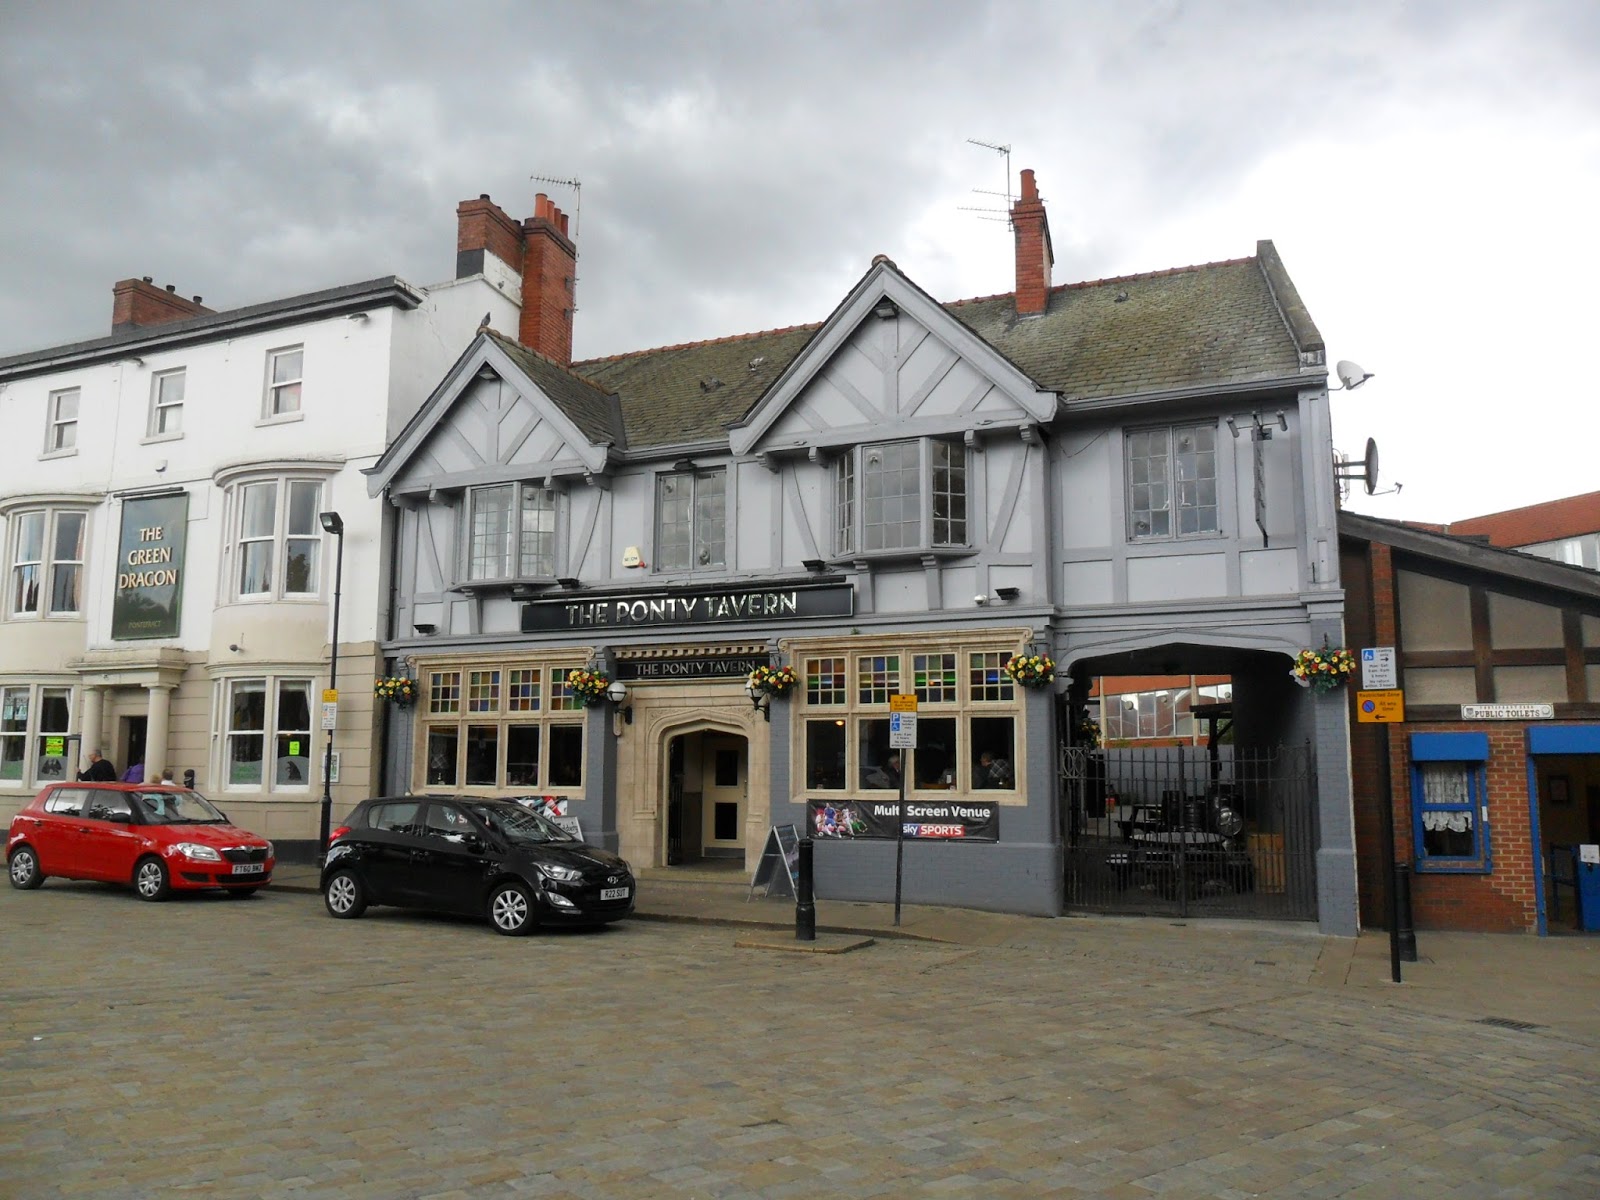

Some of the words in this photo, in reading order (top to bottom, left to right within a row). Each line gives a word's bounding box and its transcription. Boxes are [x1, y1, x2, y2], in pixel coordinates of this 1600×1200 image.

[140, 526, 164, 541] THE
[128, 547, 172, 566] GREEN
[119, 569, 178, 589] DRAGON
[565, 603, 608, 625] THE
[616, 598, 697, 623] PONTY
[704, 591, 797, 618] TAVERN
[636, 663, 659, 675] THE
[663, 661, 704, 675] PONTY
[708, 659, 756, 674] TAVERN
[1475, 710, 1504, 718] PUBLIC
[1506, 709, 1540, 718] TOILETS
[874, 805, 900, 816] Mult
[907, 805, 949, 817] Screen
[951, 806, 991, 818] Venue
[902, 824, 918, 836] sky
[920, 824, 962, 836] SPORTS
[605, 889, 616, 899] R22
